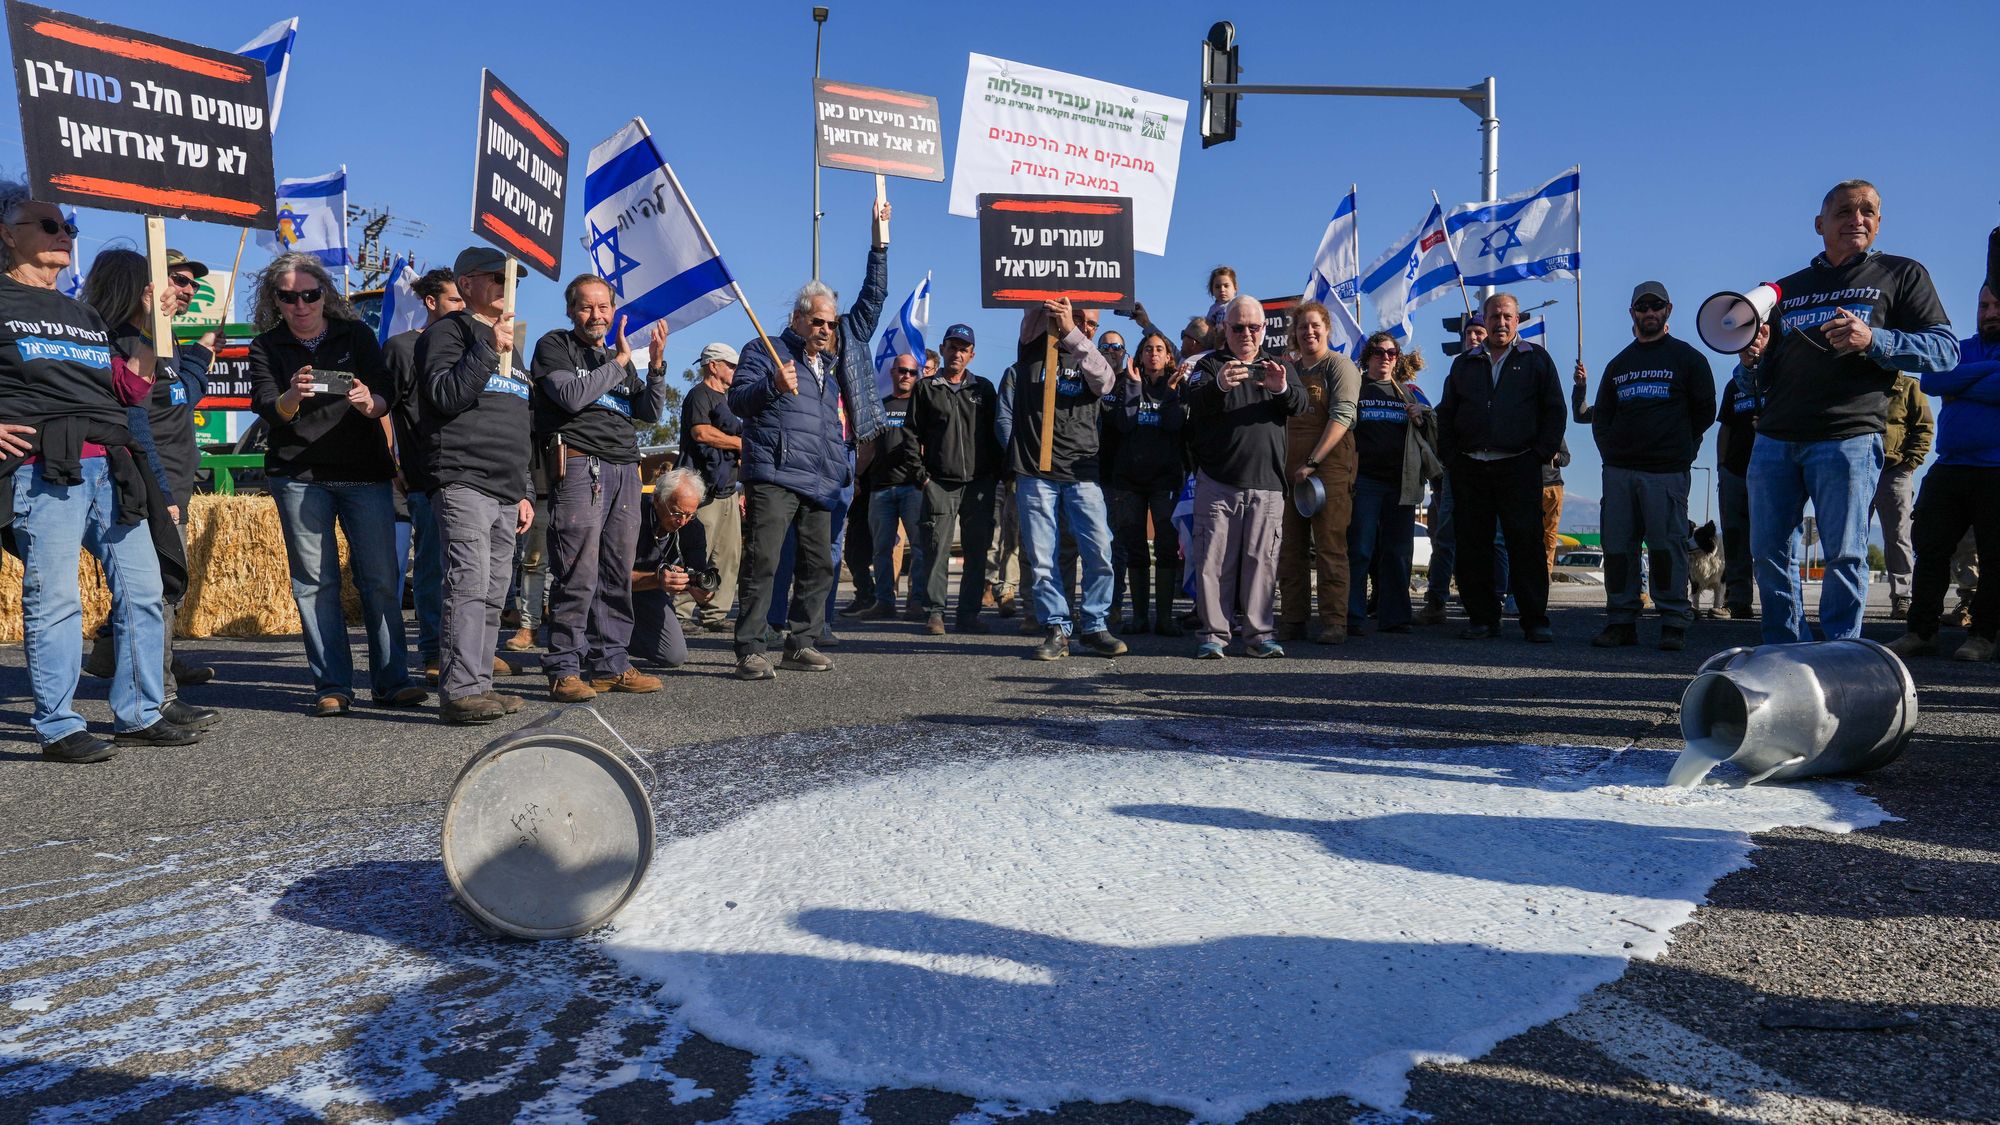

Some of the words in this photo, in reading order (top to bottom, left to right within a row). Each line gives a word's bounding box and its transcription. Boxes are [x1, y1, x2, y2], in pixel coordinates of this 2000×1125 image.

[24, 58, 123, 104] כחולבן
[987, 76, 1043, 100] הפלחה
[130, 79, 183, 117] חלב
[1008, 98, 1035, 111] ארצית
[1048, 88, 1091, 111] עובדי
[191, 95, 263, 131] שותים
[818, 101, 844, 121] כאן
[848, 106, 905, 128] מייצרים
[1037, 105, 1070, 119] חקלאית
[1071, 112, 1107, 127] שיתופית
[1095, 99, 1135, 120] ארגון
[909, 114, 937, 133] חלב
[1108, 120, 1132, 133] אגודה
[58, 116, 165, 163] ארדואן!
[487, 117, 530, 174] וביטחון
[823, 124, 879, 147] ארדואן!
[882, 131, 913, 152] אצל
[916, 137, 936, 155] לא
[988, 126, 1059, 153] הרפתנים
[171, 134, 209, 168] של
[215, 145, 248, 176] לא
[1064, 143, 1089, 159] את
[1094, 148, 1155, 174] מחבקים
[531, 153, 563, 200] ציונות
[1010, 159, 1059, 180] הצודק
[1064, 170, 1120, 193] במאבק
[491, 172, 537, 226] מייבאים
[538, 205, 554, 236] לא
[1011, 225, 1034, 246] על
[1040, 228, 1104, 247] שומרים
[995, 256, 1069, 278] הישראלי
[1075, 257, 1121, 278] החלב
[1783, 296, 1809, 310] עתיד
[1812, 293, 1829, 304] על
[1830, 286, 1880, 300] נלחמים
[4, 320, 41, 333] עתיד
[41, 320, 63, 335] על
[21, 341, 70, 357] בישראל
[1613, 373, 1628, 384] עתיד
[1630, 371, 1640, 380] על
[1641, 369, 1673, 379] נלחמים
